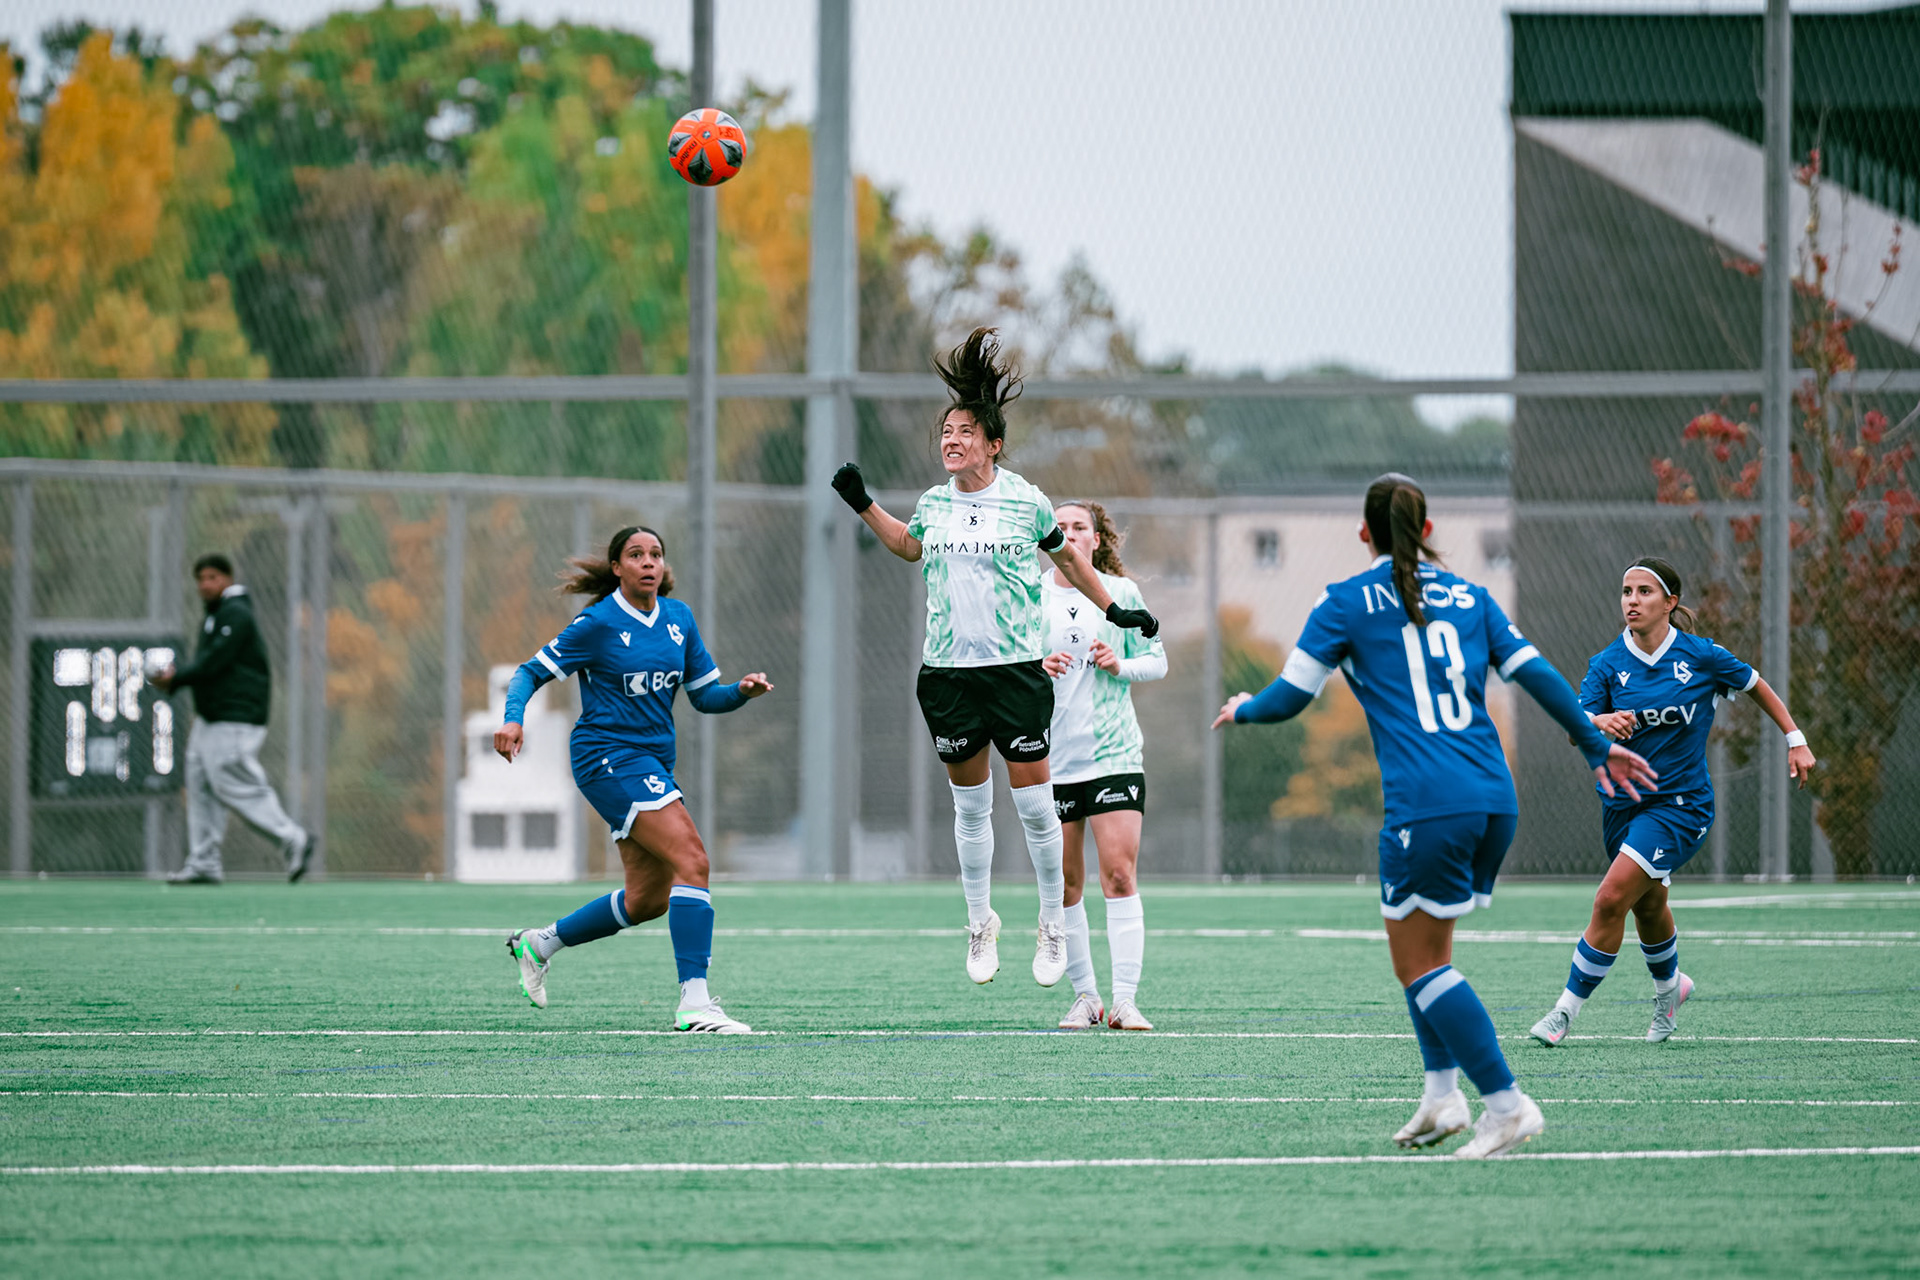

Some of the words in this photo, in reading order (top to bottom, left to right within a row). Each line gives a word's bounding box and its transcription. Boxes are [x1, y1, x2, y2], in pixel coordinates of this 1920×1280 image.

[1361, 581, 1476, 615] INOS
[1401, 619, 1473, 733] 13
[1642, 703, 1697, 727] BCV
